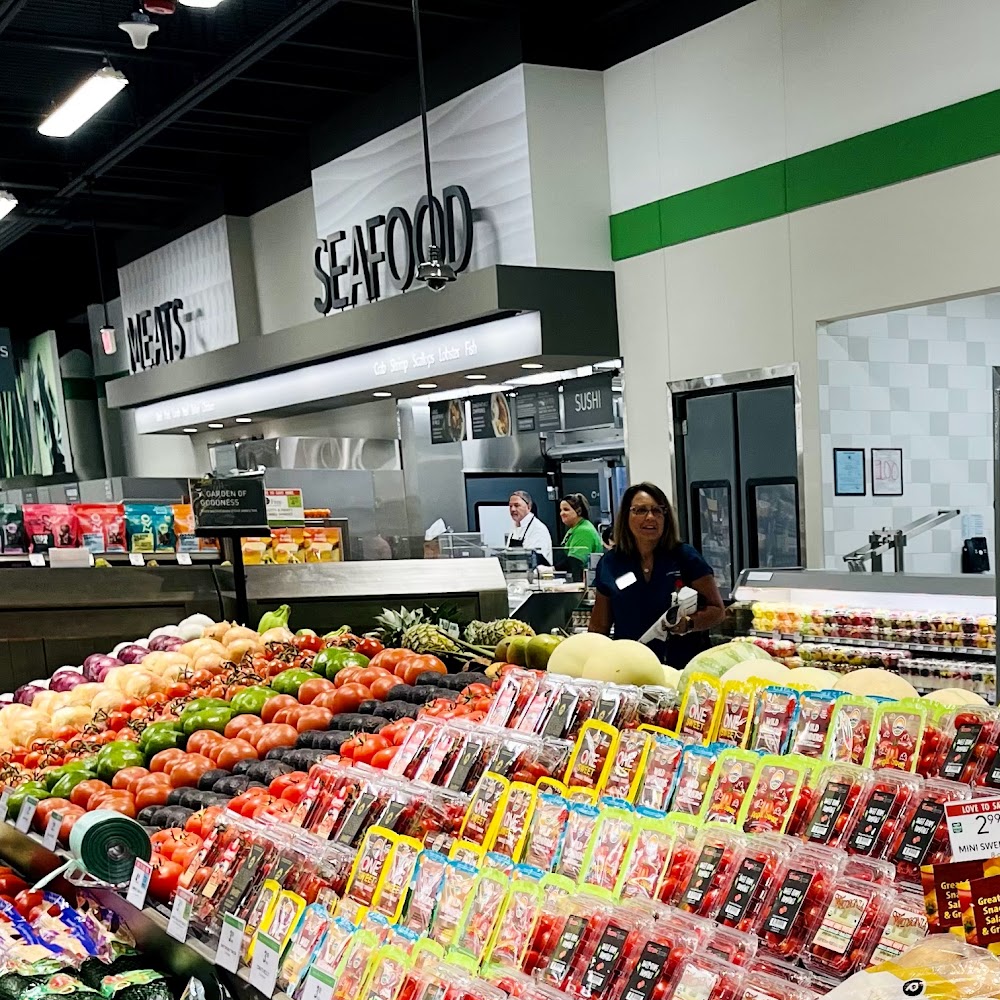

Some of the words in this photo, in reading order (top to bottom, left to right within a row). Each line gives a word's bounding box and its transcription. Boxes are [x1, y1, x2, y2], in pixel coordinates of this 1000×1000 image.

[313, 185, 473, 314] SEAFOOD
[127, 299, 187, 374] MEATS
[574, 389, 602, 412] SUSHI
[206, 490, 237, 498] GARDEN
[237, 489, 247, 497] OF
[200, 498, 239, 506] GOODNESS
[962, 804, 979, 814] LOVE
[981, 803, 990, 812] TO
[958, 844, 978, 853] MINI
[977, 895, 1000, 906] Great
